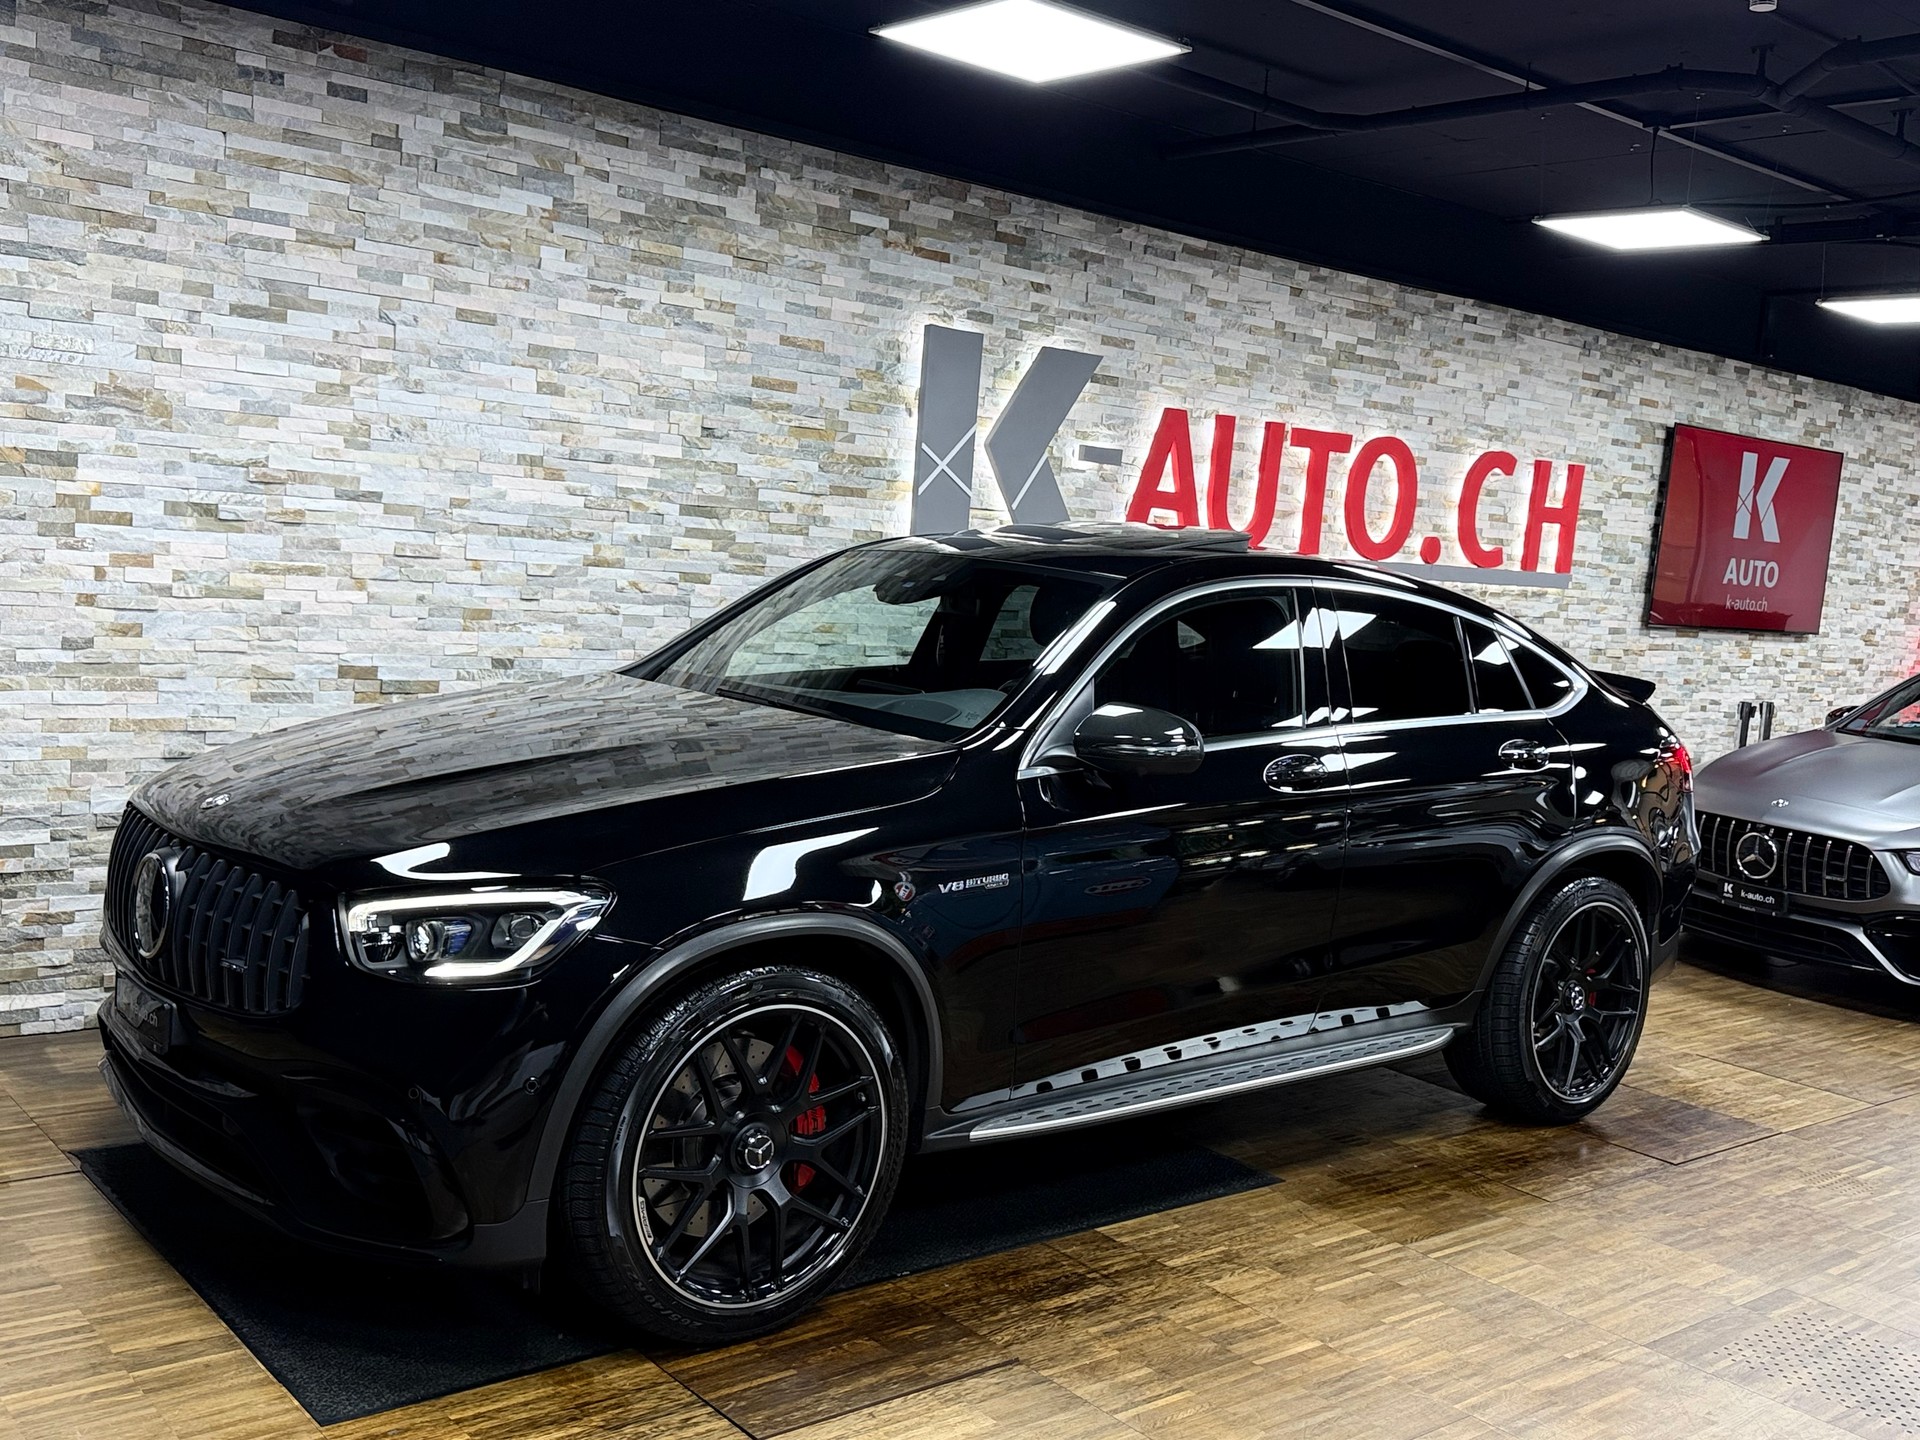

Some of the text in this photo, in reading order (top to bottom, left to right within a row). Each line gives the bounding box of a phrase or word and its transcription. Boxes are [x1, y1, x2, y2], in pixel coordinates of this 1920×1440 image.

[1733, 451, 1791, 544] K
[1722, 557, 1780, 589] AUTO
[1724, 594, 1769, 612] k-auto.ch
[938, 880, 965, 894] V8
[1740, 889, 1776, 905] k-auto.ch
